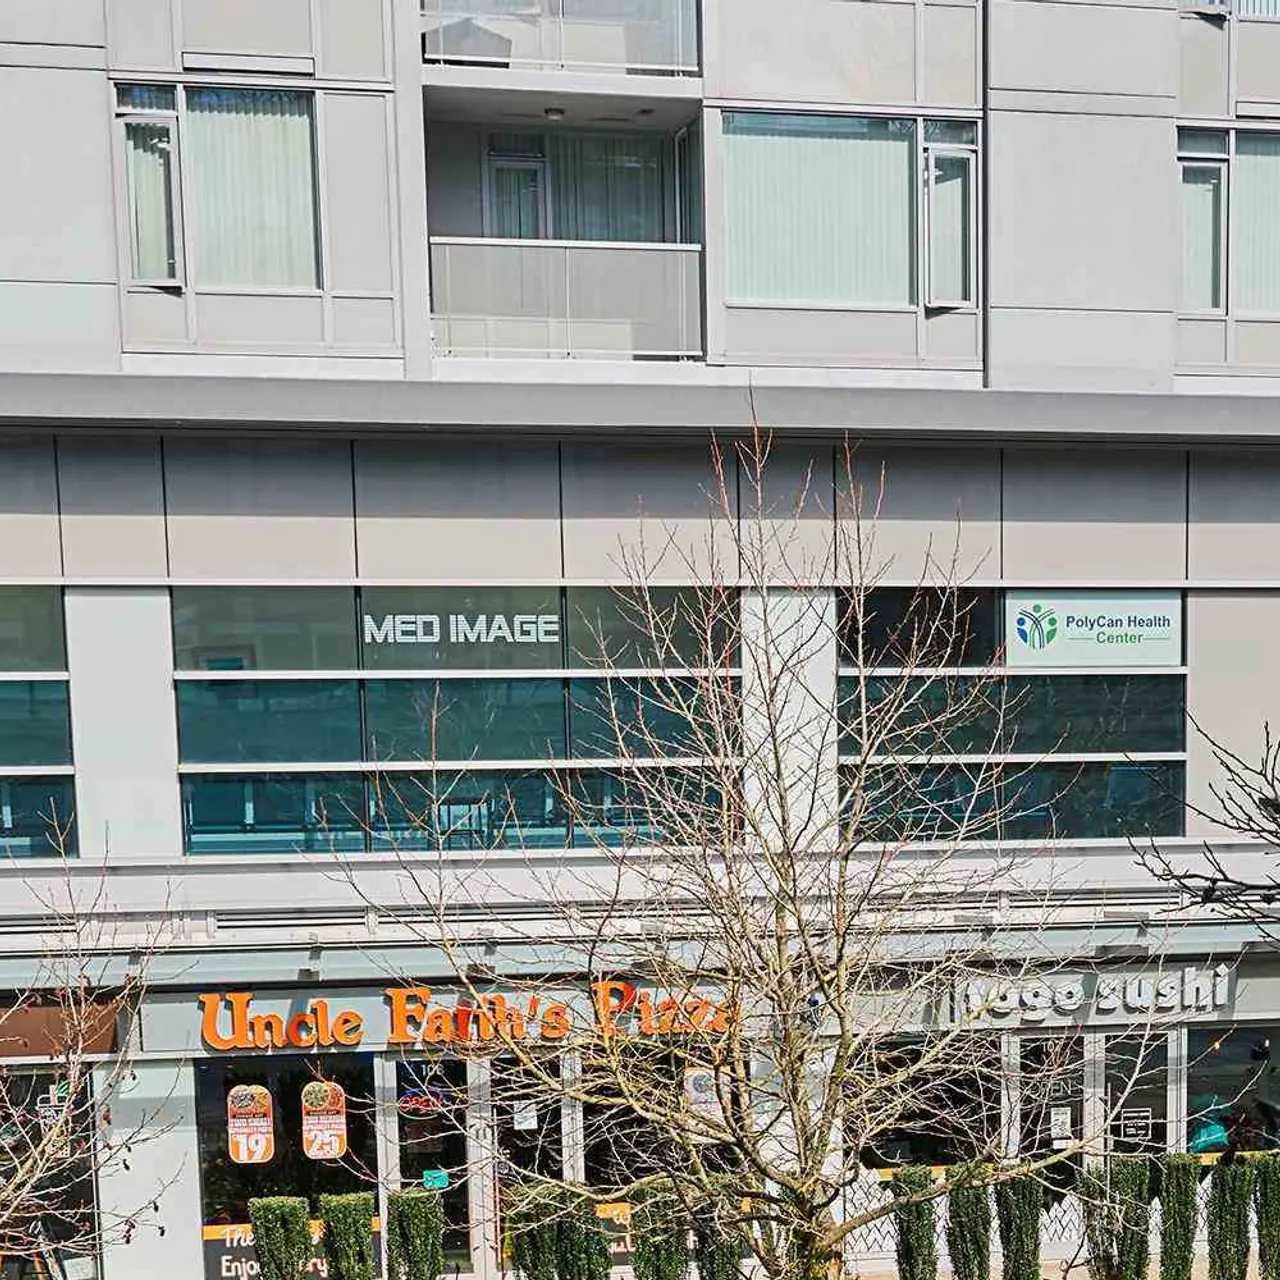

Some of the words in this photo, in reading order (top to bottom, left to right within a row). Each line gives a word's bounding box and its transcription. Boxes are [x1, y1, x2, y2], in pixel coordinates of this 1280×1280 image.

[364, 614, 440, 643] MED
[449, 614, 559, 643] IMAGE
[1066, 616, 1123, 631] PolyCan
[1127, 615, 1171, 628] Health
[1096, 631, 1143, 644] Center
[1096, 963, 1229, 1012] sushi
[199, 992, 363, 1050] Uncle
